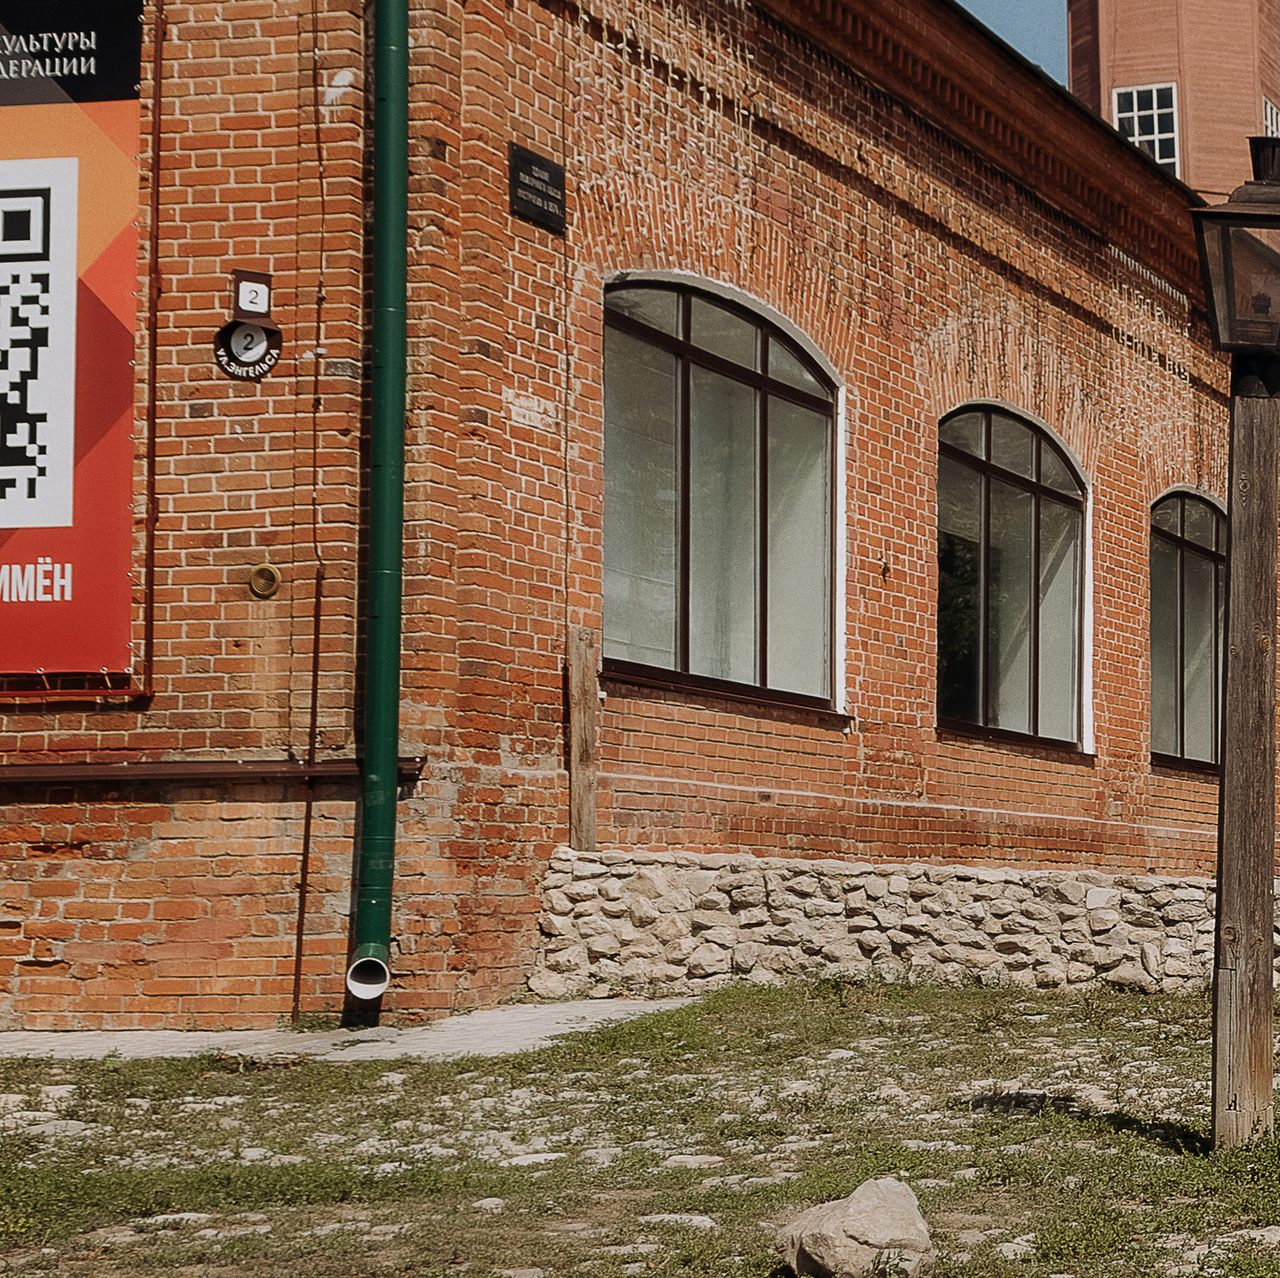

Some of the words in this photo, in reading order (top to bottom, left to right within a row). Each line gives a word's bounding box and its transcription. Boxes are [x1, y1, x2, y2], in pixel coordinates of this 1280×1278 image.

[0, 31, 97, 55] УЛЬТУРЫ
[248, 289, 259, 305] 2
[242, 332, 255, 351] 2
